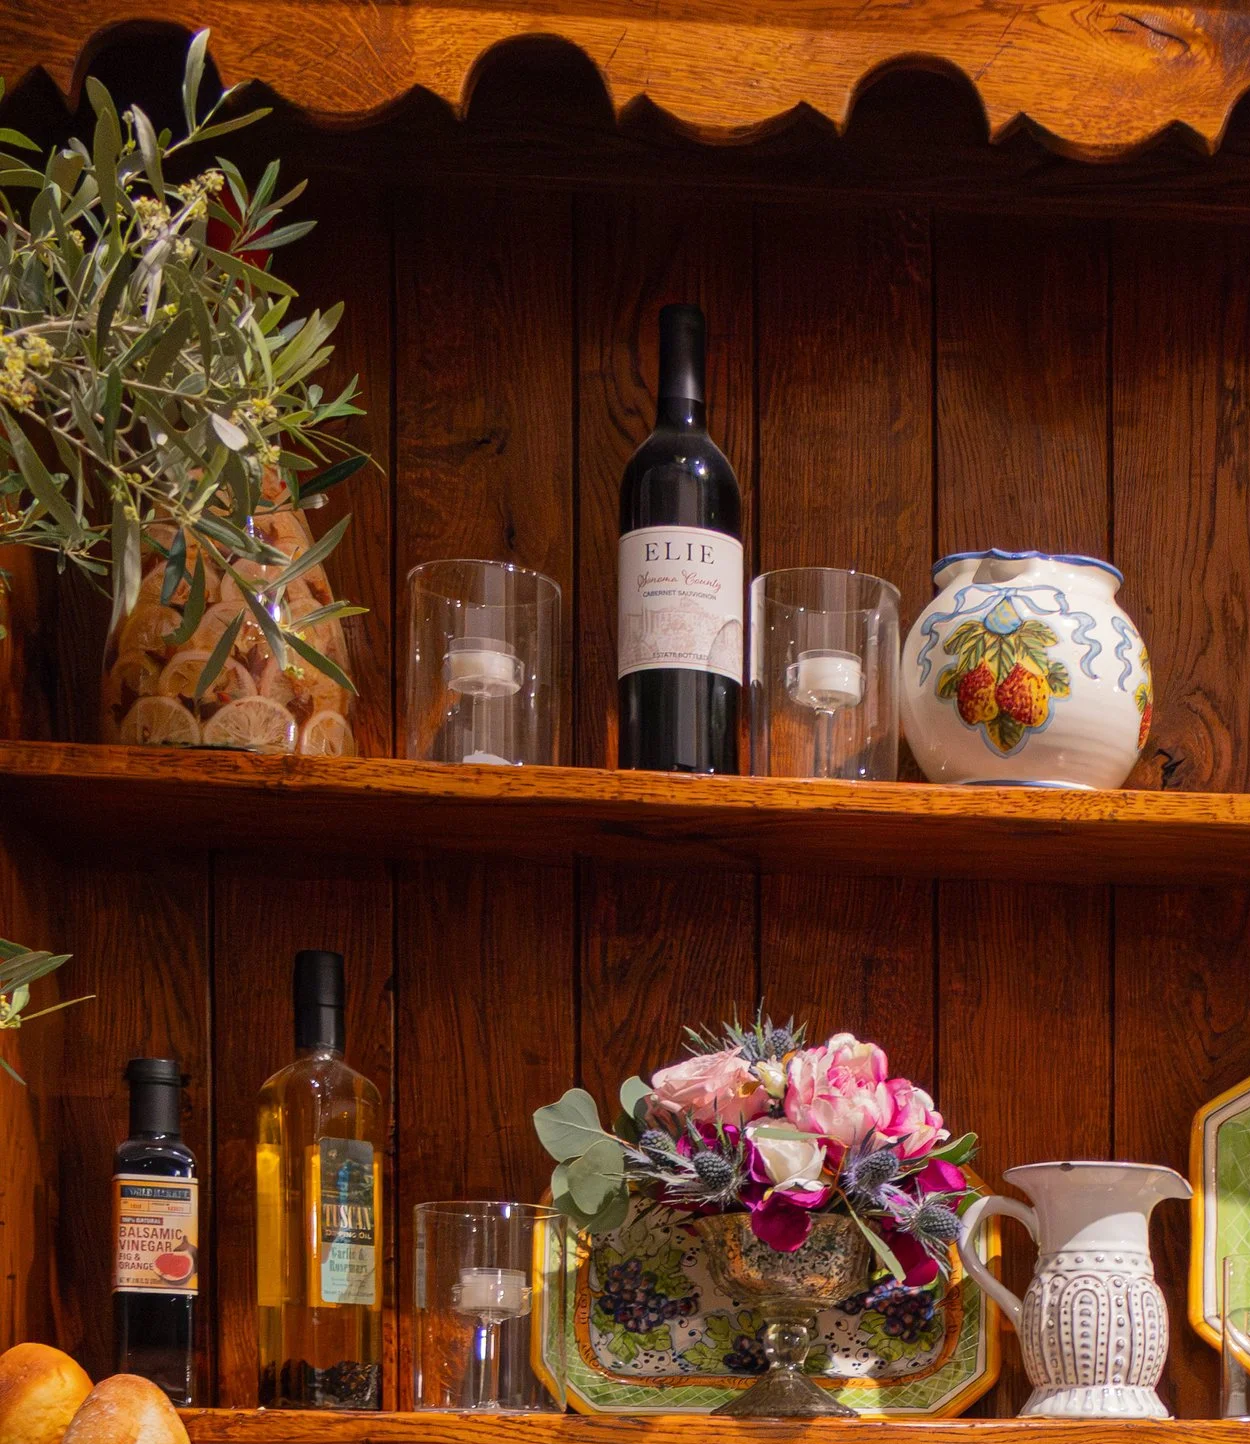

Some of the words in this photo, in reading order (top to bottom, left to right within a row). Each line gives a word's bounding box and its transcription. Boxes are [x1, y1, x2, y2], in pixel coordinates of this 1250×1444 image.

[644, 541, 715, 565] ELIE
[681, 569, 722, 593] County
[642, 590, 676, 598] CABERNET
[322, 1204, 372, 1231] TUSCAN
[119, 1226, 183, 1240] BALSAMIC
[359, 1232, 372, 1240] OIL
[119, 1240, 172, 1252] VINEGAR
[119, 1252, 132, 1260] FIG
[119, 1261, 153, 1270] ORANGE
